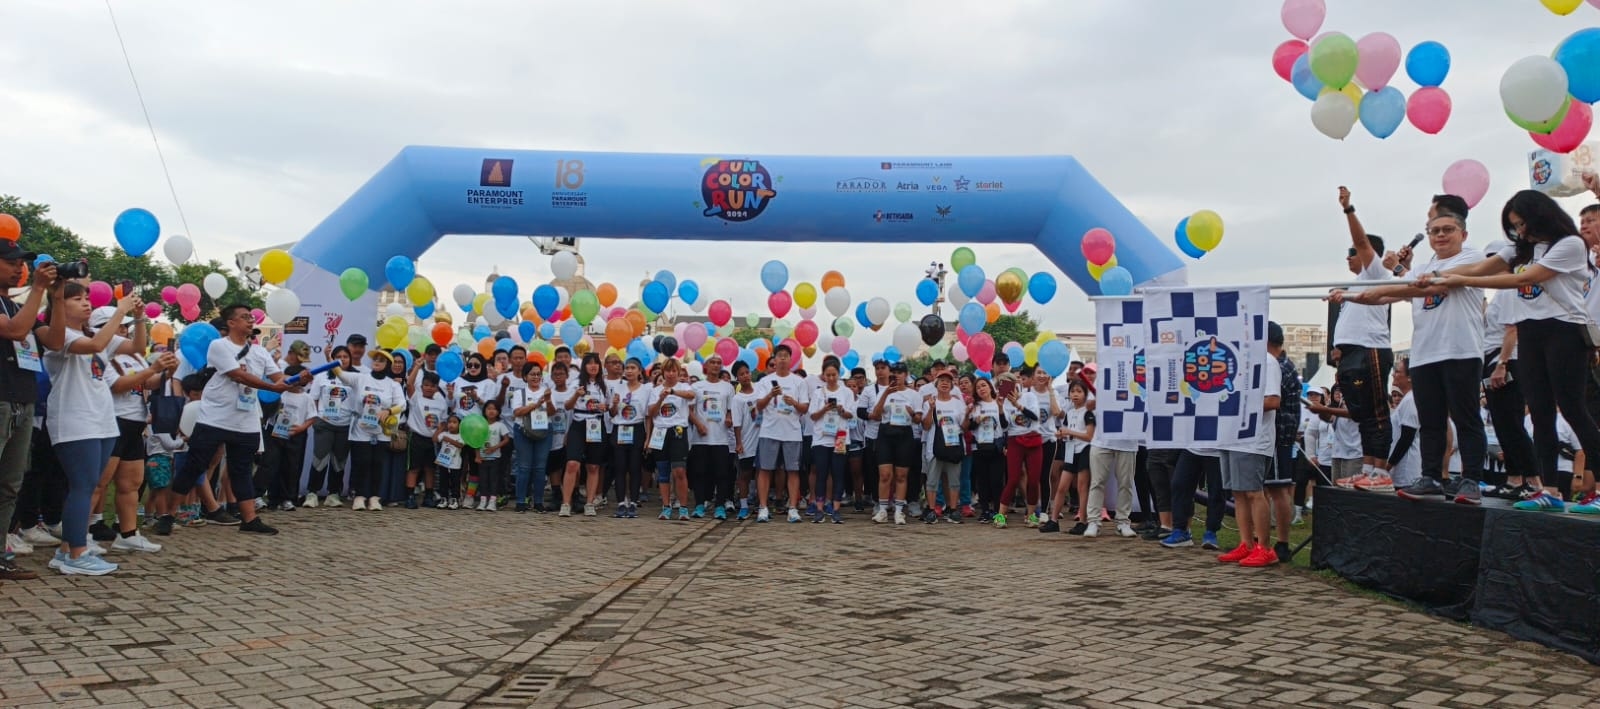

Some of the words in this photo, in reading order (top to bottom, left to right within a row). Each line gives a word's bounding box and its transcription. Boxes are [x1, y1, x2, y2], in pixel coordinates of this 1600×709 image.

[720, 162, 756, 172] FUN
[556, 159, 584, 190] 18
[706, 173, 767, 189] COLOR
[836, 182, 887, 190] PARADOR
[897, 182, 918, 190] Atria
[467, 189, 524, 198] PARAMOUNT
[712, 190, 762, 209] RUN
[467, 197, 524, 206] ENTERPRISE
[1112, 336, 1124, 348] 18
[1160, 332, 1175, 345] 18
[1185, 352, 1197, 382] FUN
[1197, 344, 1212, 391] COLOR
[1211, 347, 1228, 387] RUN
